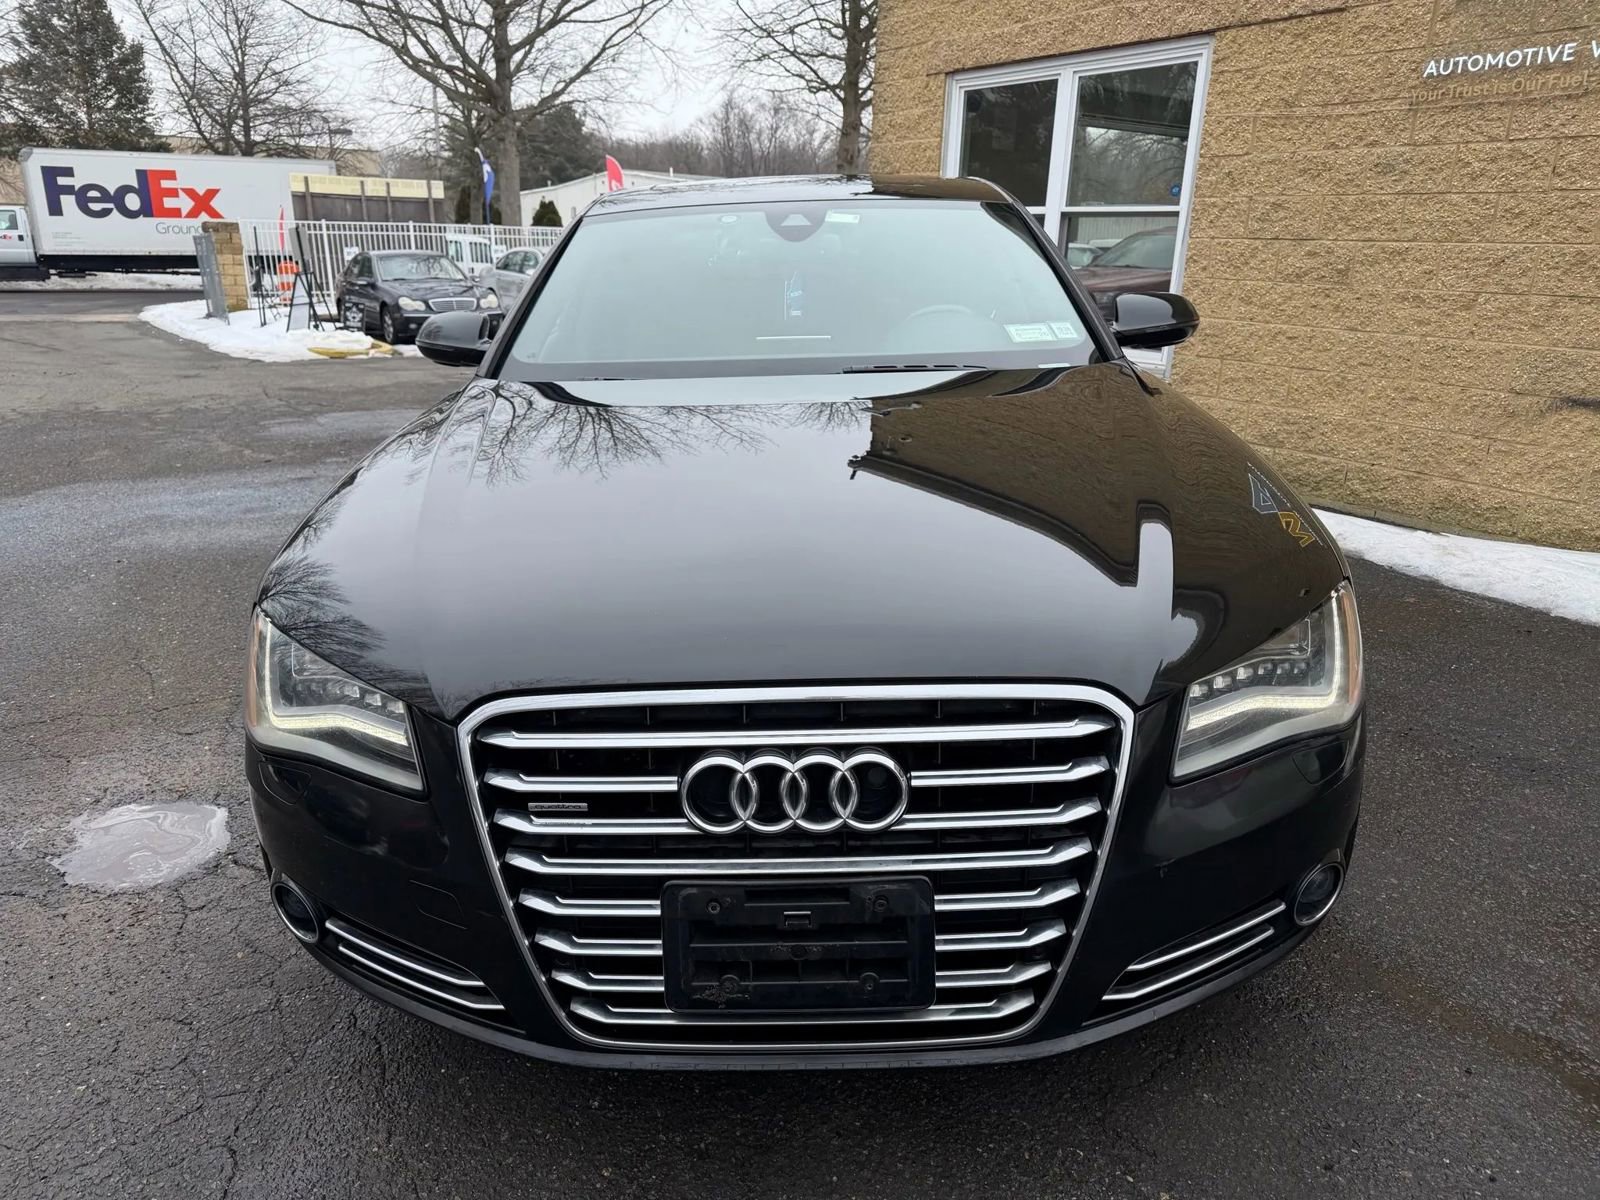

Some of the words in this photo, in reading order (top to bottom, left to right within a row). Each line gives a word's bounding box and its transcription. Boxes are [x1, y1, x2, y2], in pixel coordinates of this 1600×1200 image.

[1423, 43, 1577, 78] AUTOMOTIVE
[1411, 88, 1447, 105] Your
[1449, 82, 1490, 98] Trust
[1511, 76, 1546, 92] Our
[1549, 69, 1589, 89] Fuel
[40, 165, 225, 219] FedEx
